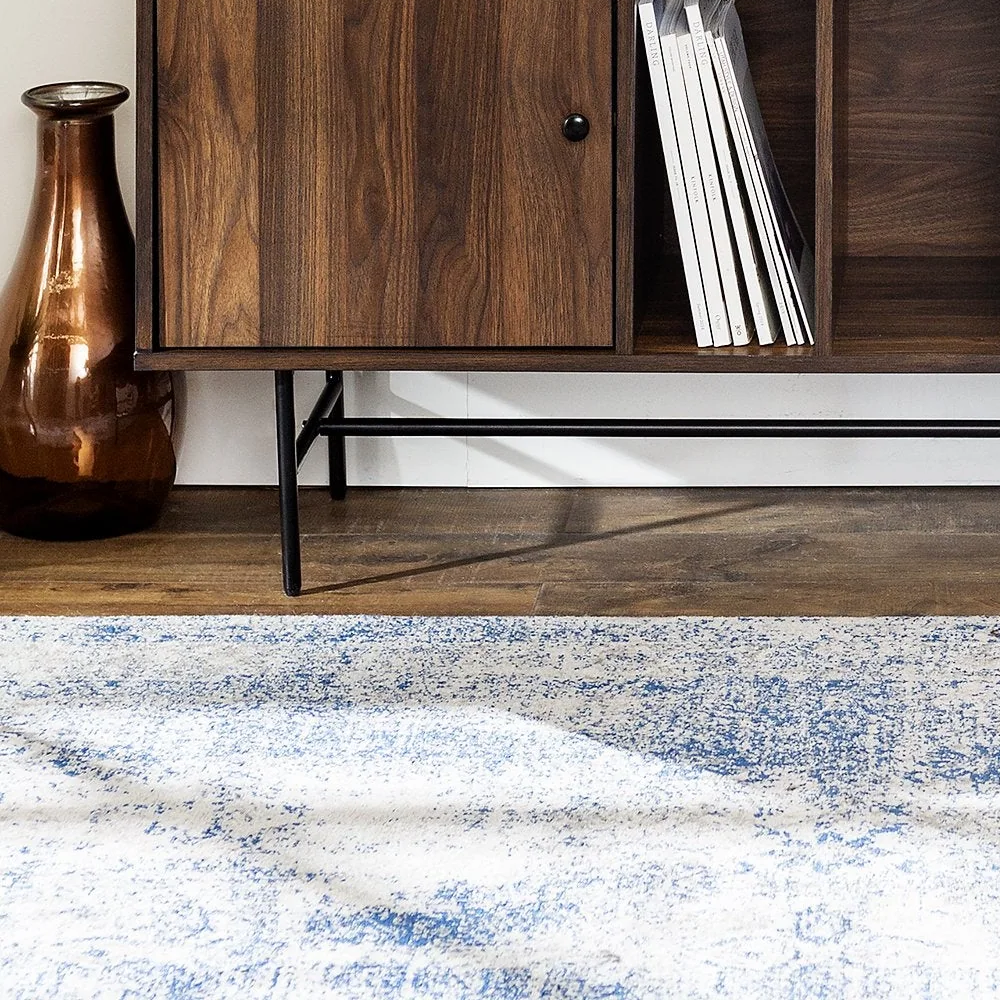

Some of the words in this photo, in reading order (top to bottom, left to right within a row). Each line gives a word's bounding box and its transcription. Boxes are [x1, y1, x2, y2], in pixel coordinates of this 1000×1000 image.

[646, 21, 660, 67] DARLING
[693, 20, 709, 66] DARLING
[691, 175, 699, 203] KINFOLK
[708, 173, 716, 201] KINFOLK
